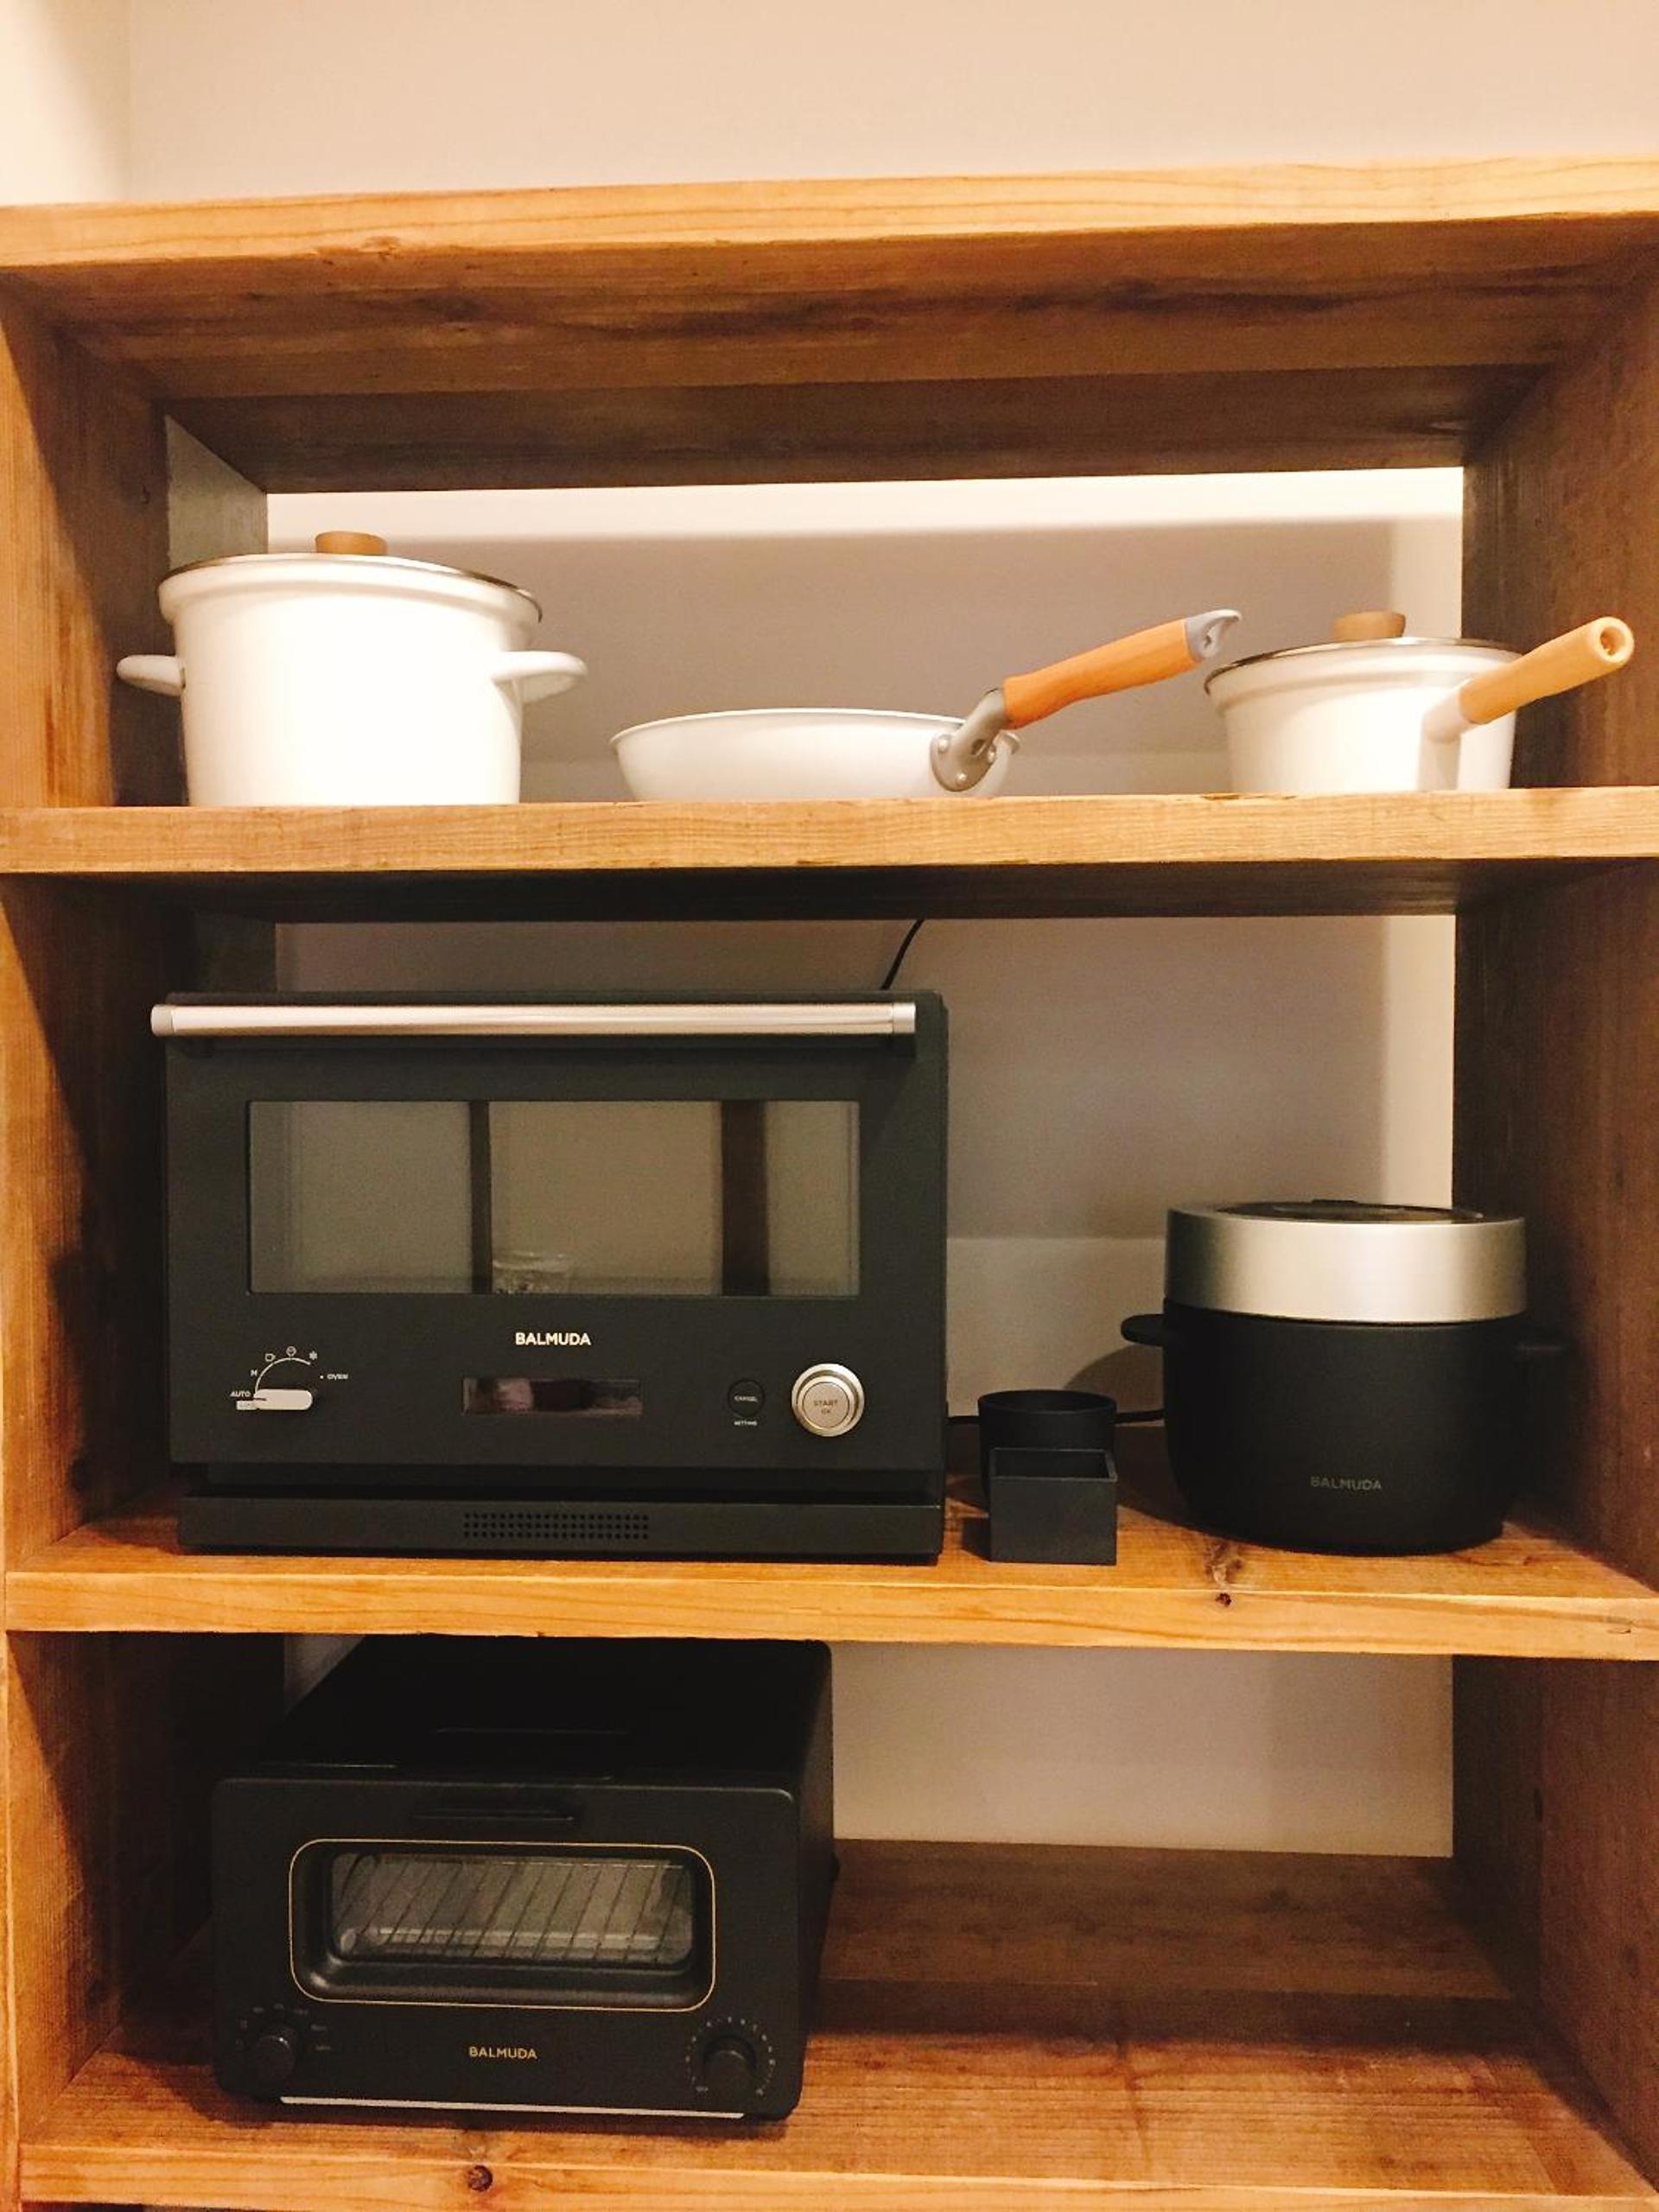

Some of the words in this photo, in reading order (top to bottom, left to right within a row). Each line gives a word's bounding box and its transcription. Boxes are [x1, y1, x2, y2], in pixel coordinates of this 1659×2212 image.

[515, 1332, 592, 1345] BALMUDA
[229, 1389, 251, 1398] AUTO
[813, 1399, 838, 1408] START
[1310, 1476, 1382, 1491] BALMUDA
[468, 2045, 538, 2060] BALMUDA
